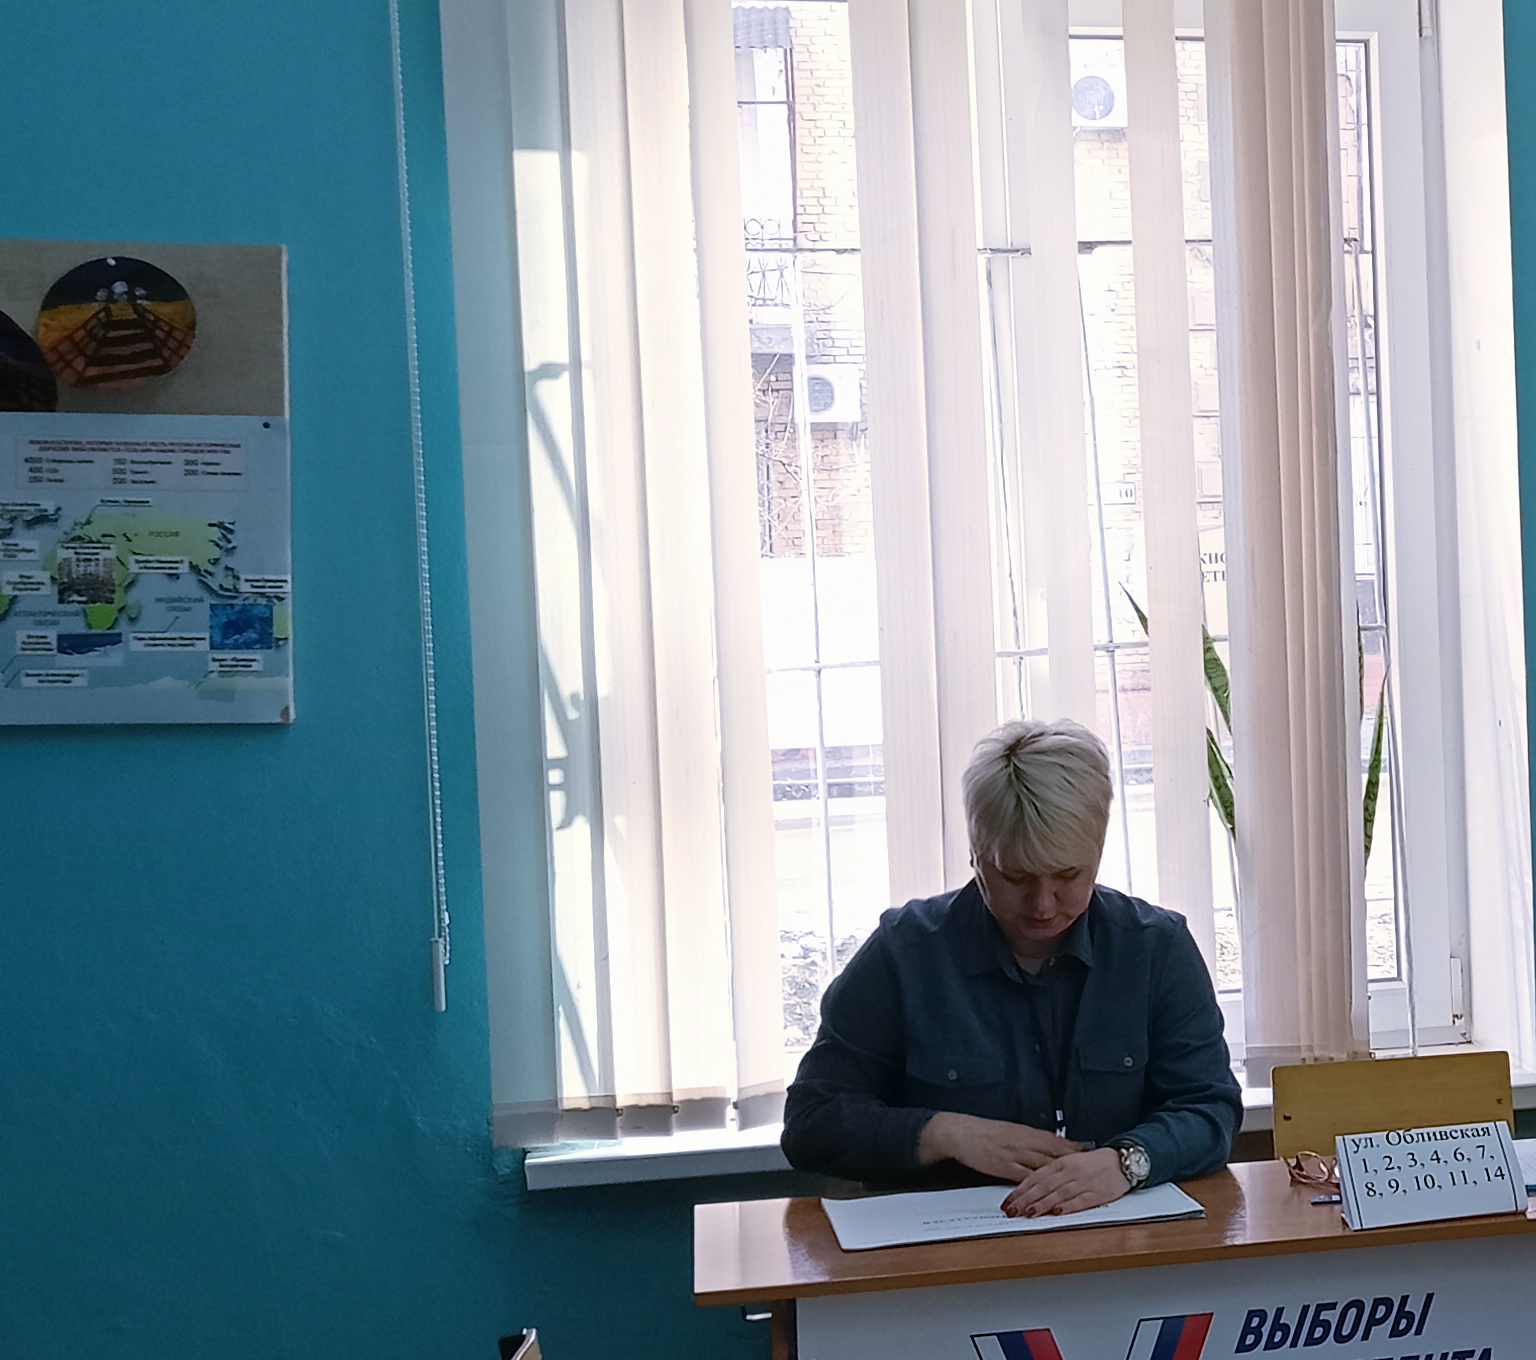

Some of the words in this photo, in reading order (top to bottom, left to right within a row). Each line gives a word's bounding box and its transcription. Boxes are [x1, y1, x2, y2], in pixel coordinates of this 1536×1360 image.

[1351, 1137, 1380, 1153] ул.
[1386, 1126, 1491, 1146] Обливская
[1361, 1158, 1378, 1175] 1,
[1382, 1155, 1401, 1171] 2,
[1406, 1152, 1425, 1169] 3,
[1430, 1149, 1448, 1165] 4,
[1453, 1147, 1472, 1163] 6,
[1476, 1144, 1495, 1161] 7,
[1364, 1181, 1383, 1199] 8,
[1388, 1178, 1407, 1194] 9,
[1414, 1174, 1442, 1191] 10,
[1450, 1170, 1478, 1186] 11,
[1485, 1166, 1506, 1182] 14
[1234, 1292, 1435, 1355] ВЫБОРЫ
